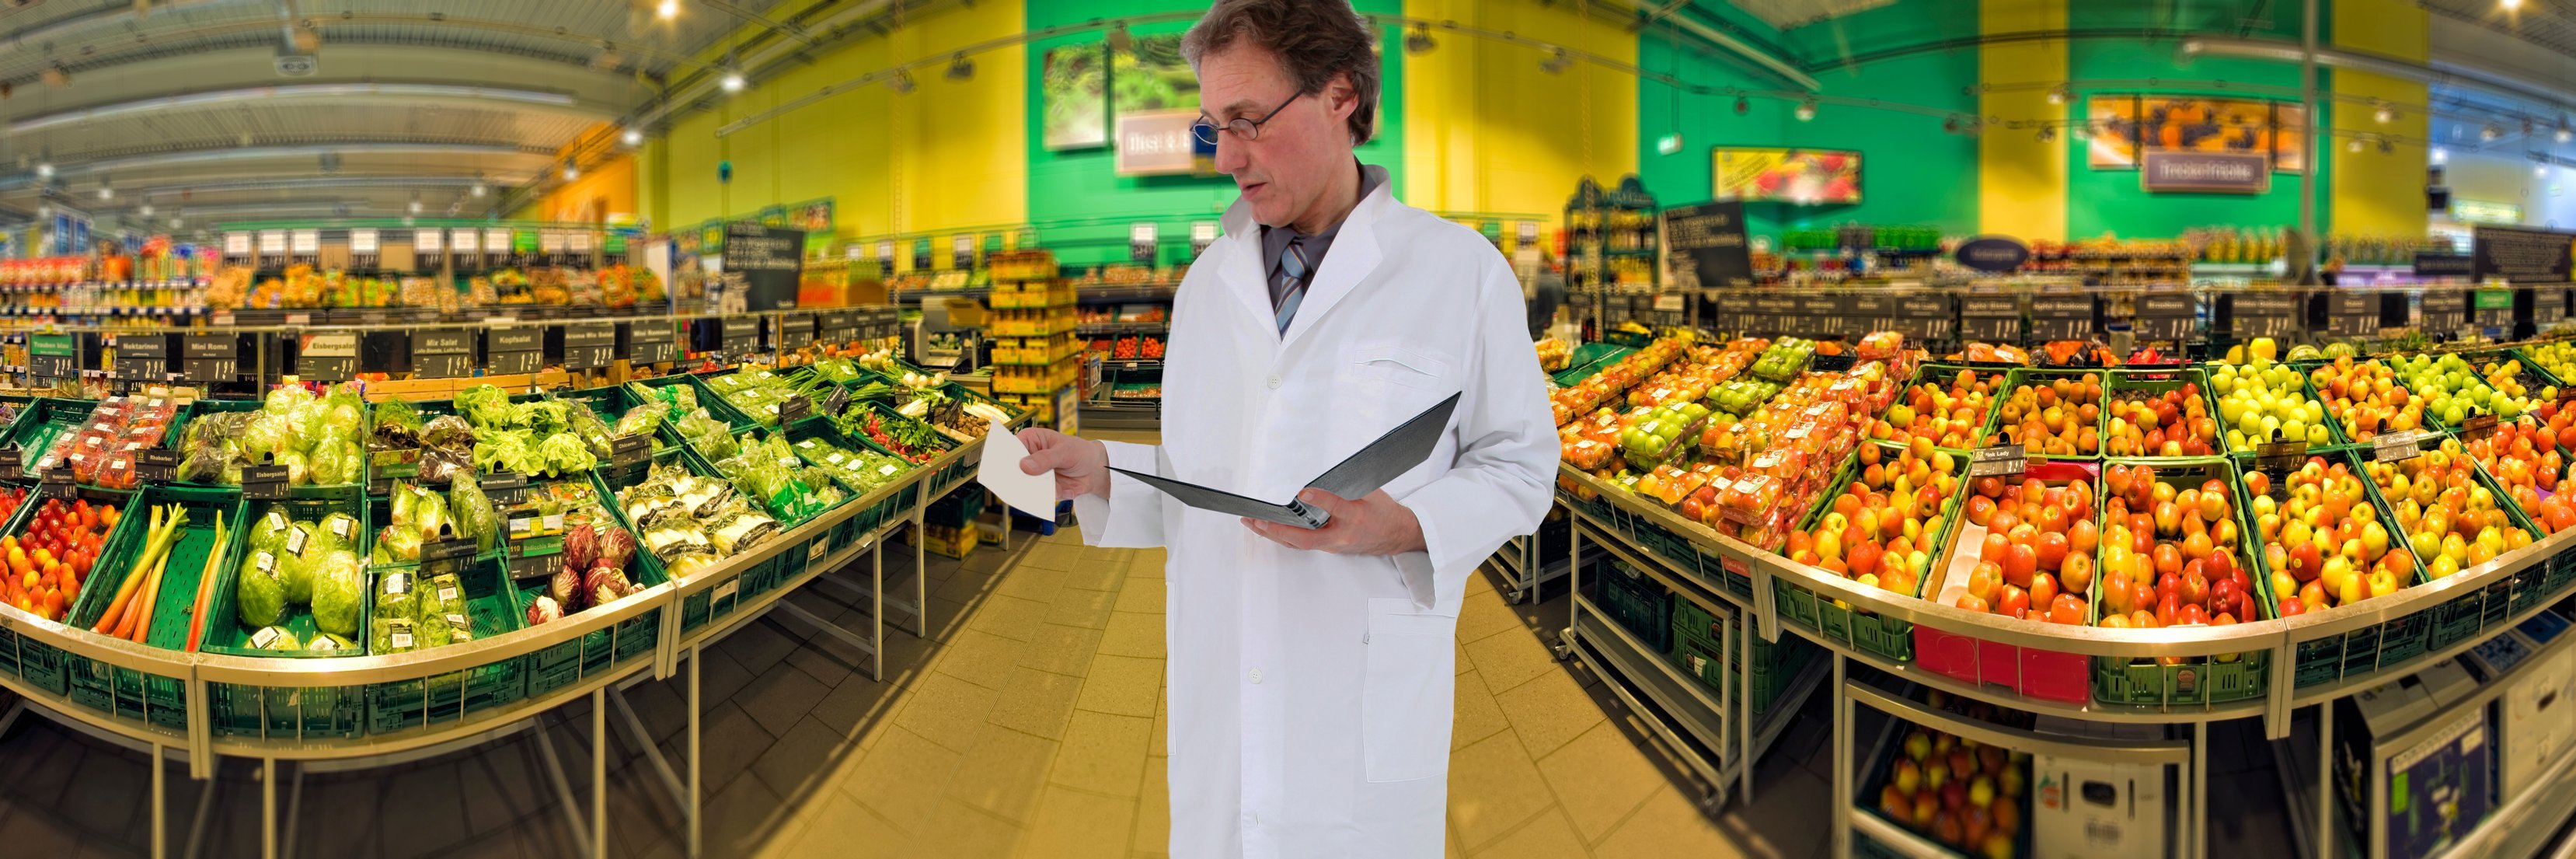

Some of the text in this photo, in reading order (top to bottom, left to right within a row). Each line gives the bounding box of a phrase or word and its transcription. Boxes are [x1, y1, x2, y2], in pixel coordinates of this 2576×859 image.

[440, 338, 458, 347] Salat
[499, 336, 532, 344] Kopfsalat
[312, 342, 356, 351] Eisbergsalat
[436, 544, 478, 553] Kopfsalatherzen
